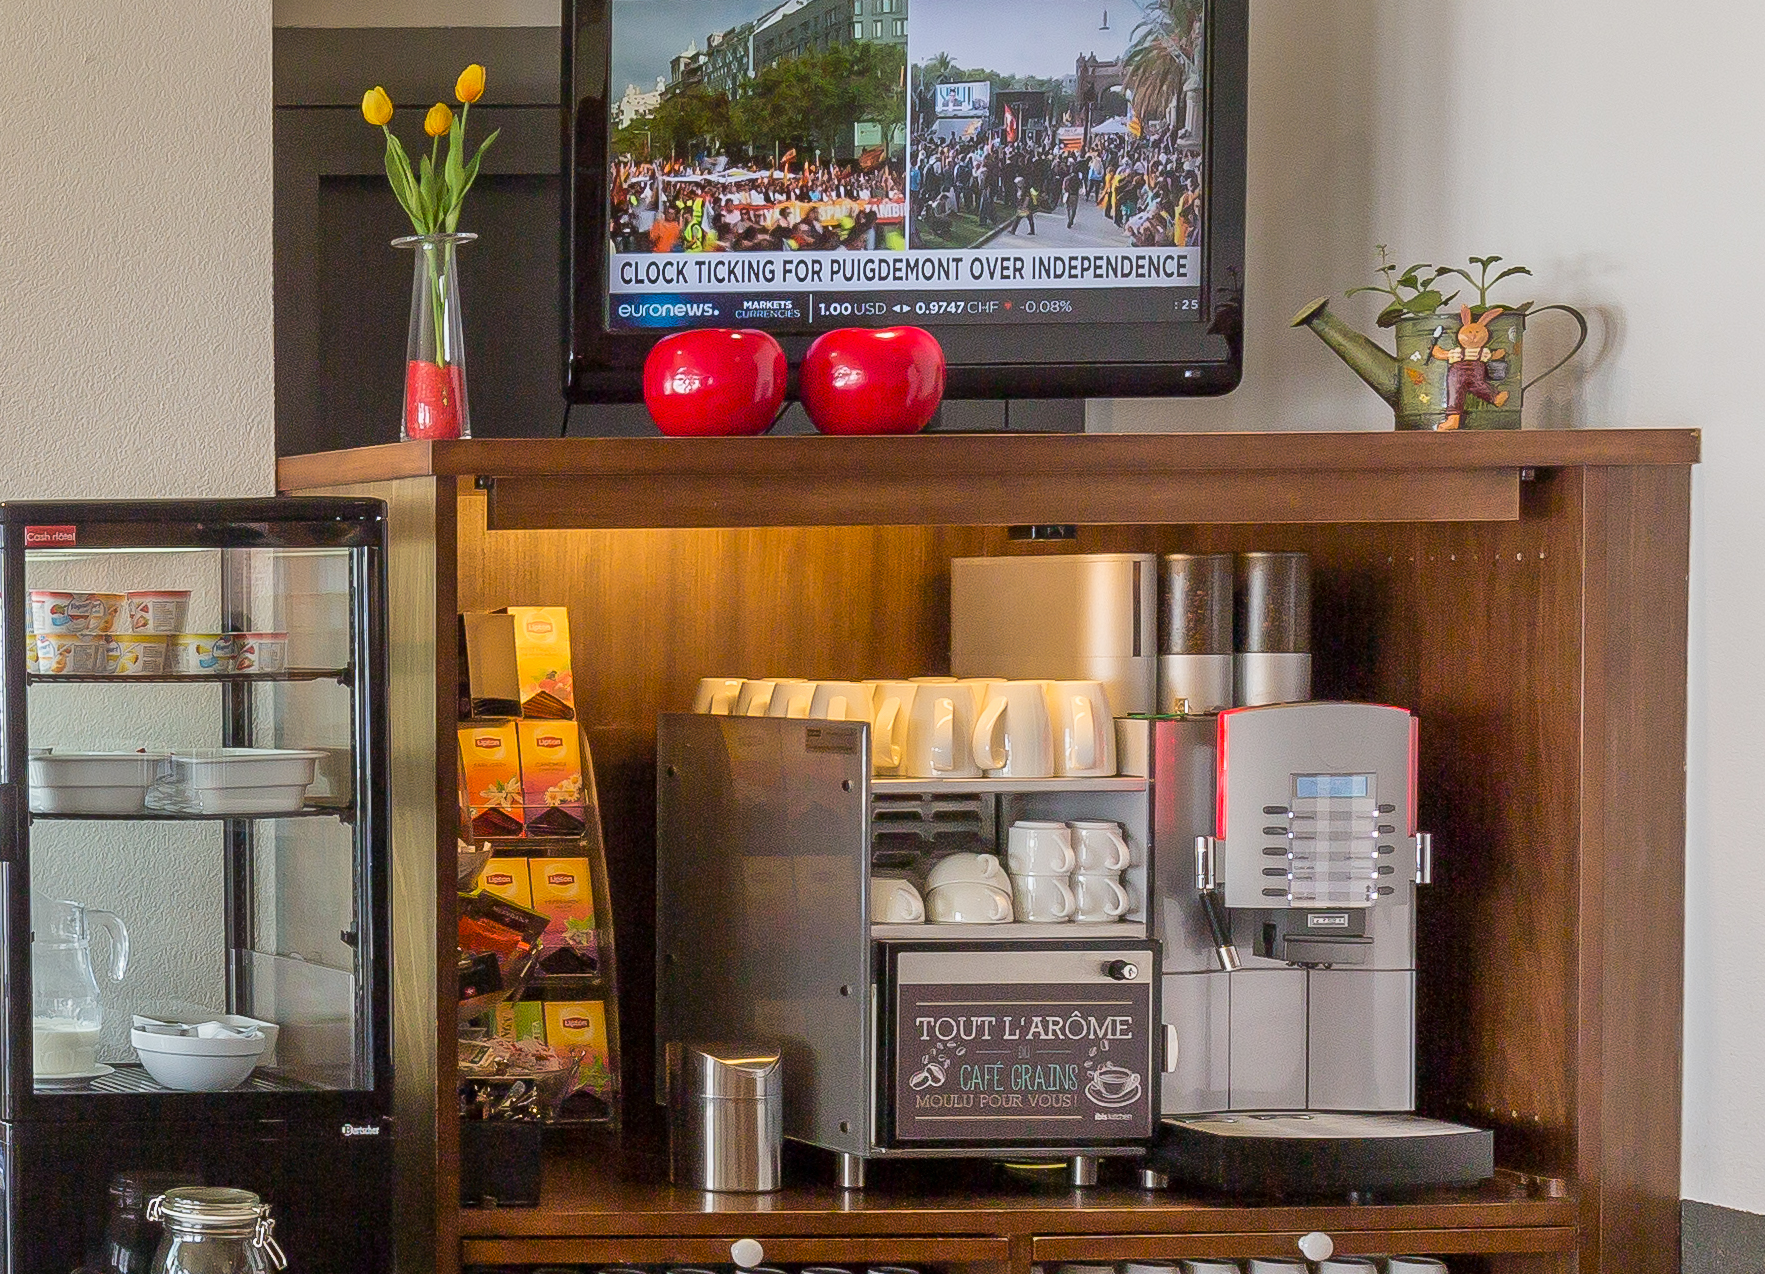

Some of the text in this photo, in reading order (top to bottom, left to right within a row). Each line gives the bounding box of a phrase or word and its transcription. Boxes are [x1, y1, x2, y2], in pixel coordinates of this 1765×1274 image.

[620, 254, 1189, 285] CLOCK TICKING FOR PUIGDEMONT OVER INDEPENDENCE
[743, 300, 793, 309] MARKETS
[818, 300, 1073, 315] 1.00 USD 0.9747 CHF -0.08%
[735, 309, 801, 319] CURRENCIES
[915, 1011, 1132, 1040] TOUT L'ARÔME
[960, 1061, 1079, 1091] CAFÉ GRAINS
[915, 1094, 974, 1109] MOULU
[980, 1094, 1023, 1108] POUR
